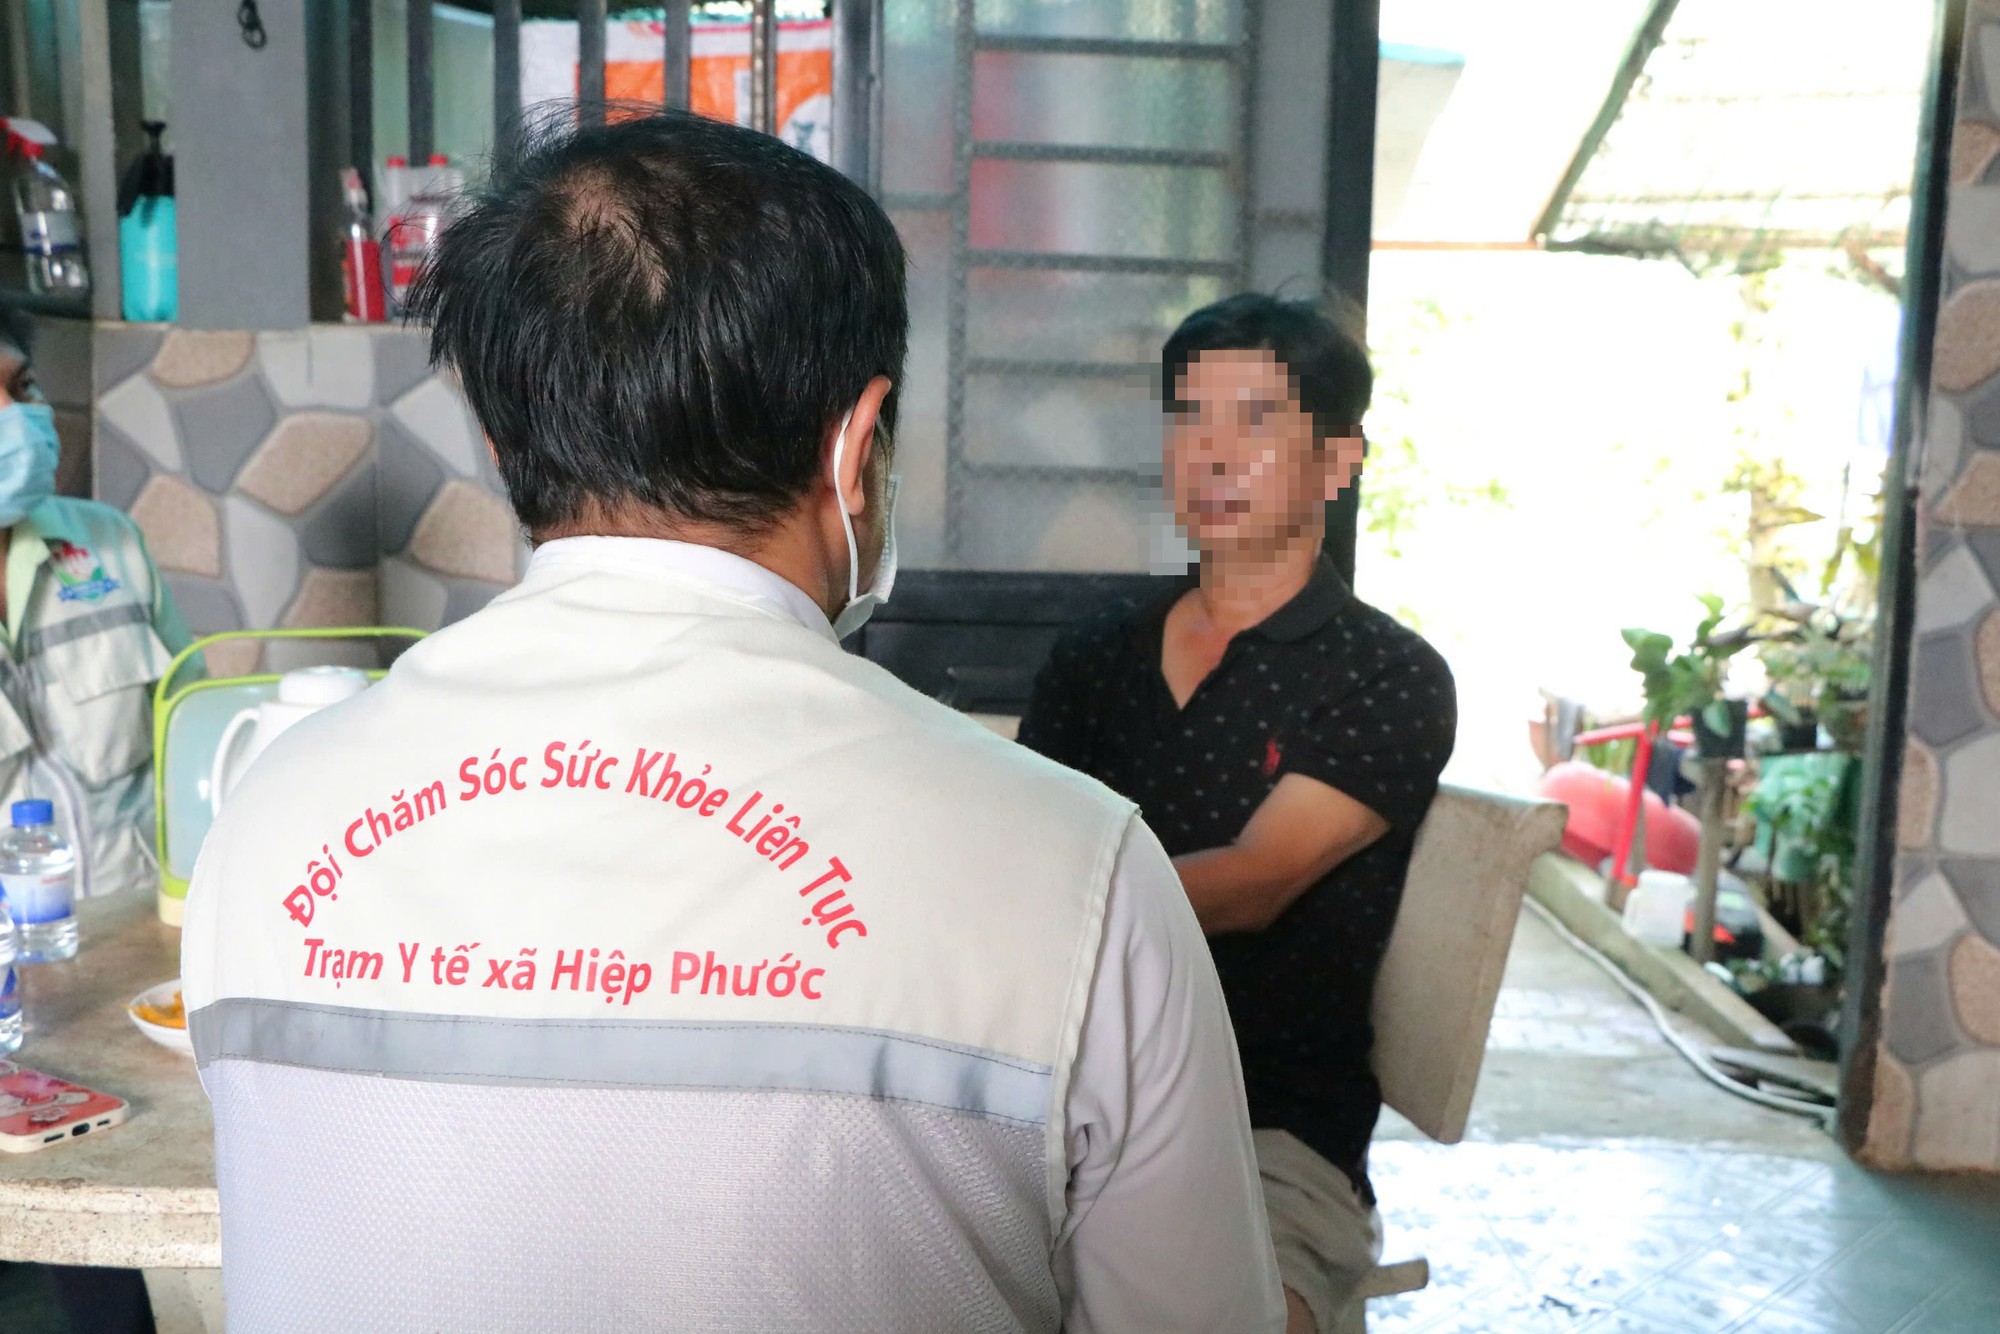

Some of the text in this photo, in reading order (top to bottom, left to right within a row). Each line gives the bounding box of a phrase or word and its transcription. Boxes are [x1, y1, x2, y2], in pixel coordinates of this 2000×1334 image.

[281, 739, 869, 950] Đội Chăm Sóc Sức Khỏe Liên Tục
[302, 937, 827, 1007] Trạm Y tế xã Hiệp Phước
